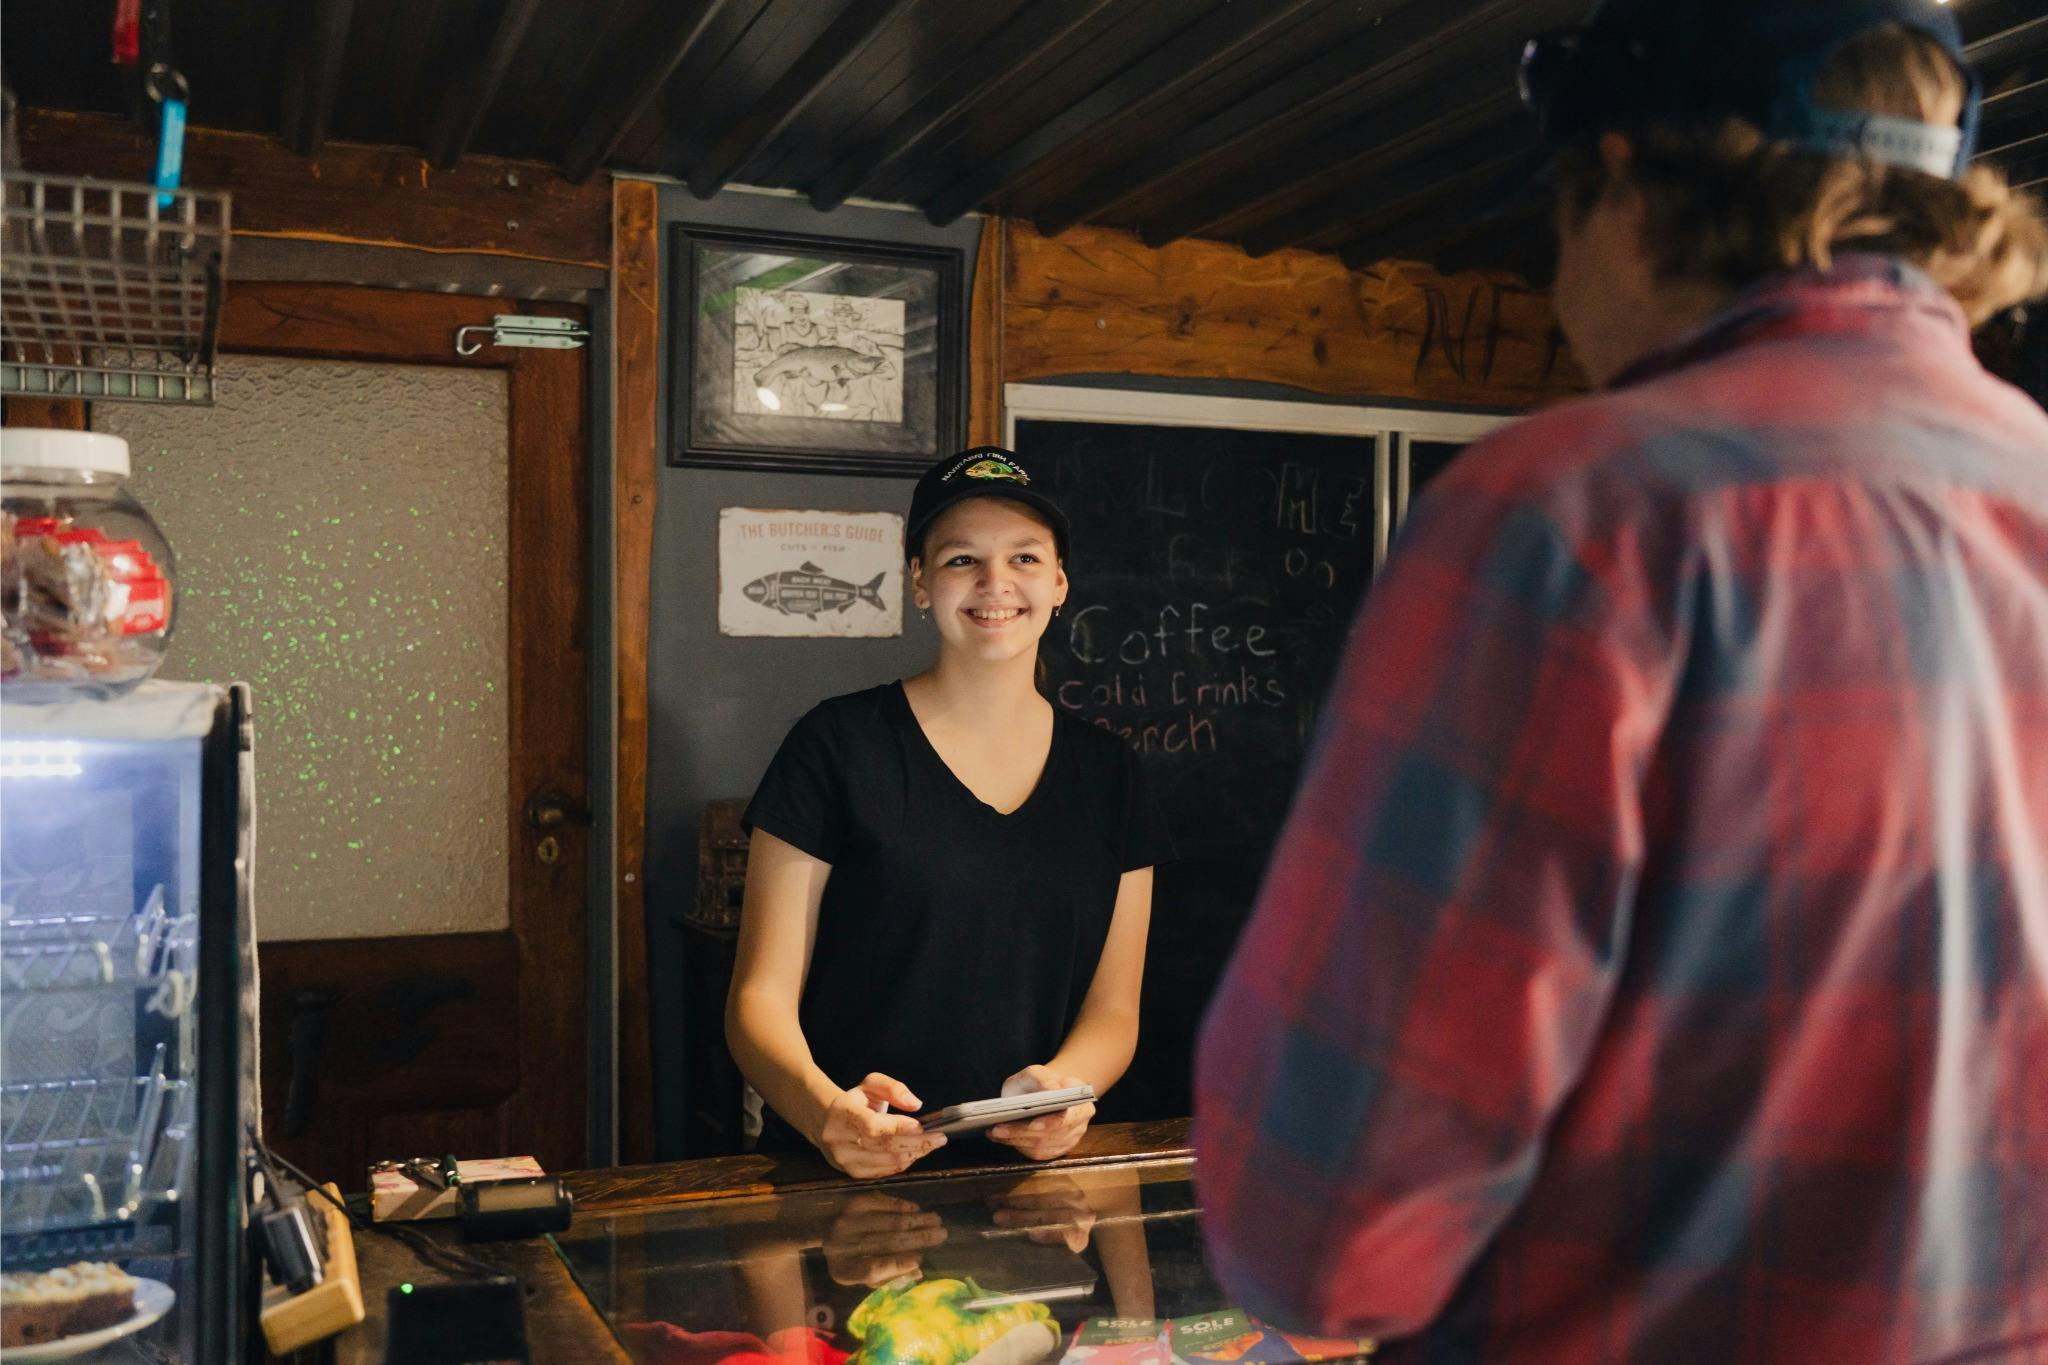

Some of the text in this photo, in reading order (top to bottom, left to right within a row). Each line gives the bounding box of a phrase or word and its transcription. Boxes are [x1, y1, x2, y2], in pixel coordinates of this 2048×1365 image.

[740, 522, 885, 543] THE BUTCHER'S GUIDE
[1070, 602, 1276, 665] Coffee
[1180, 1317, 1233, 1335] SOLE
